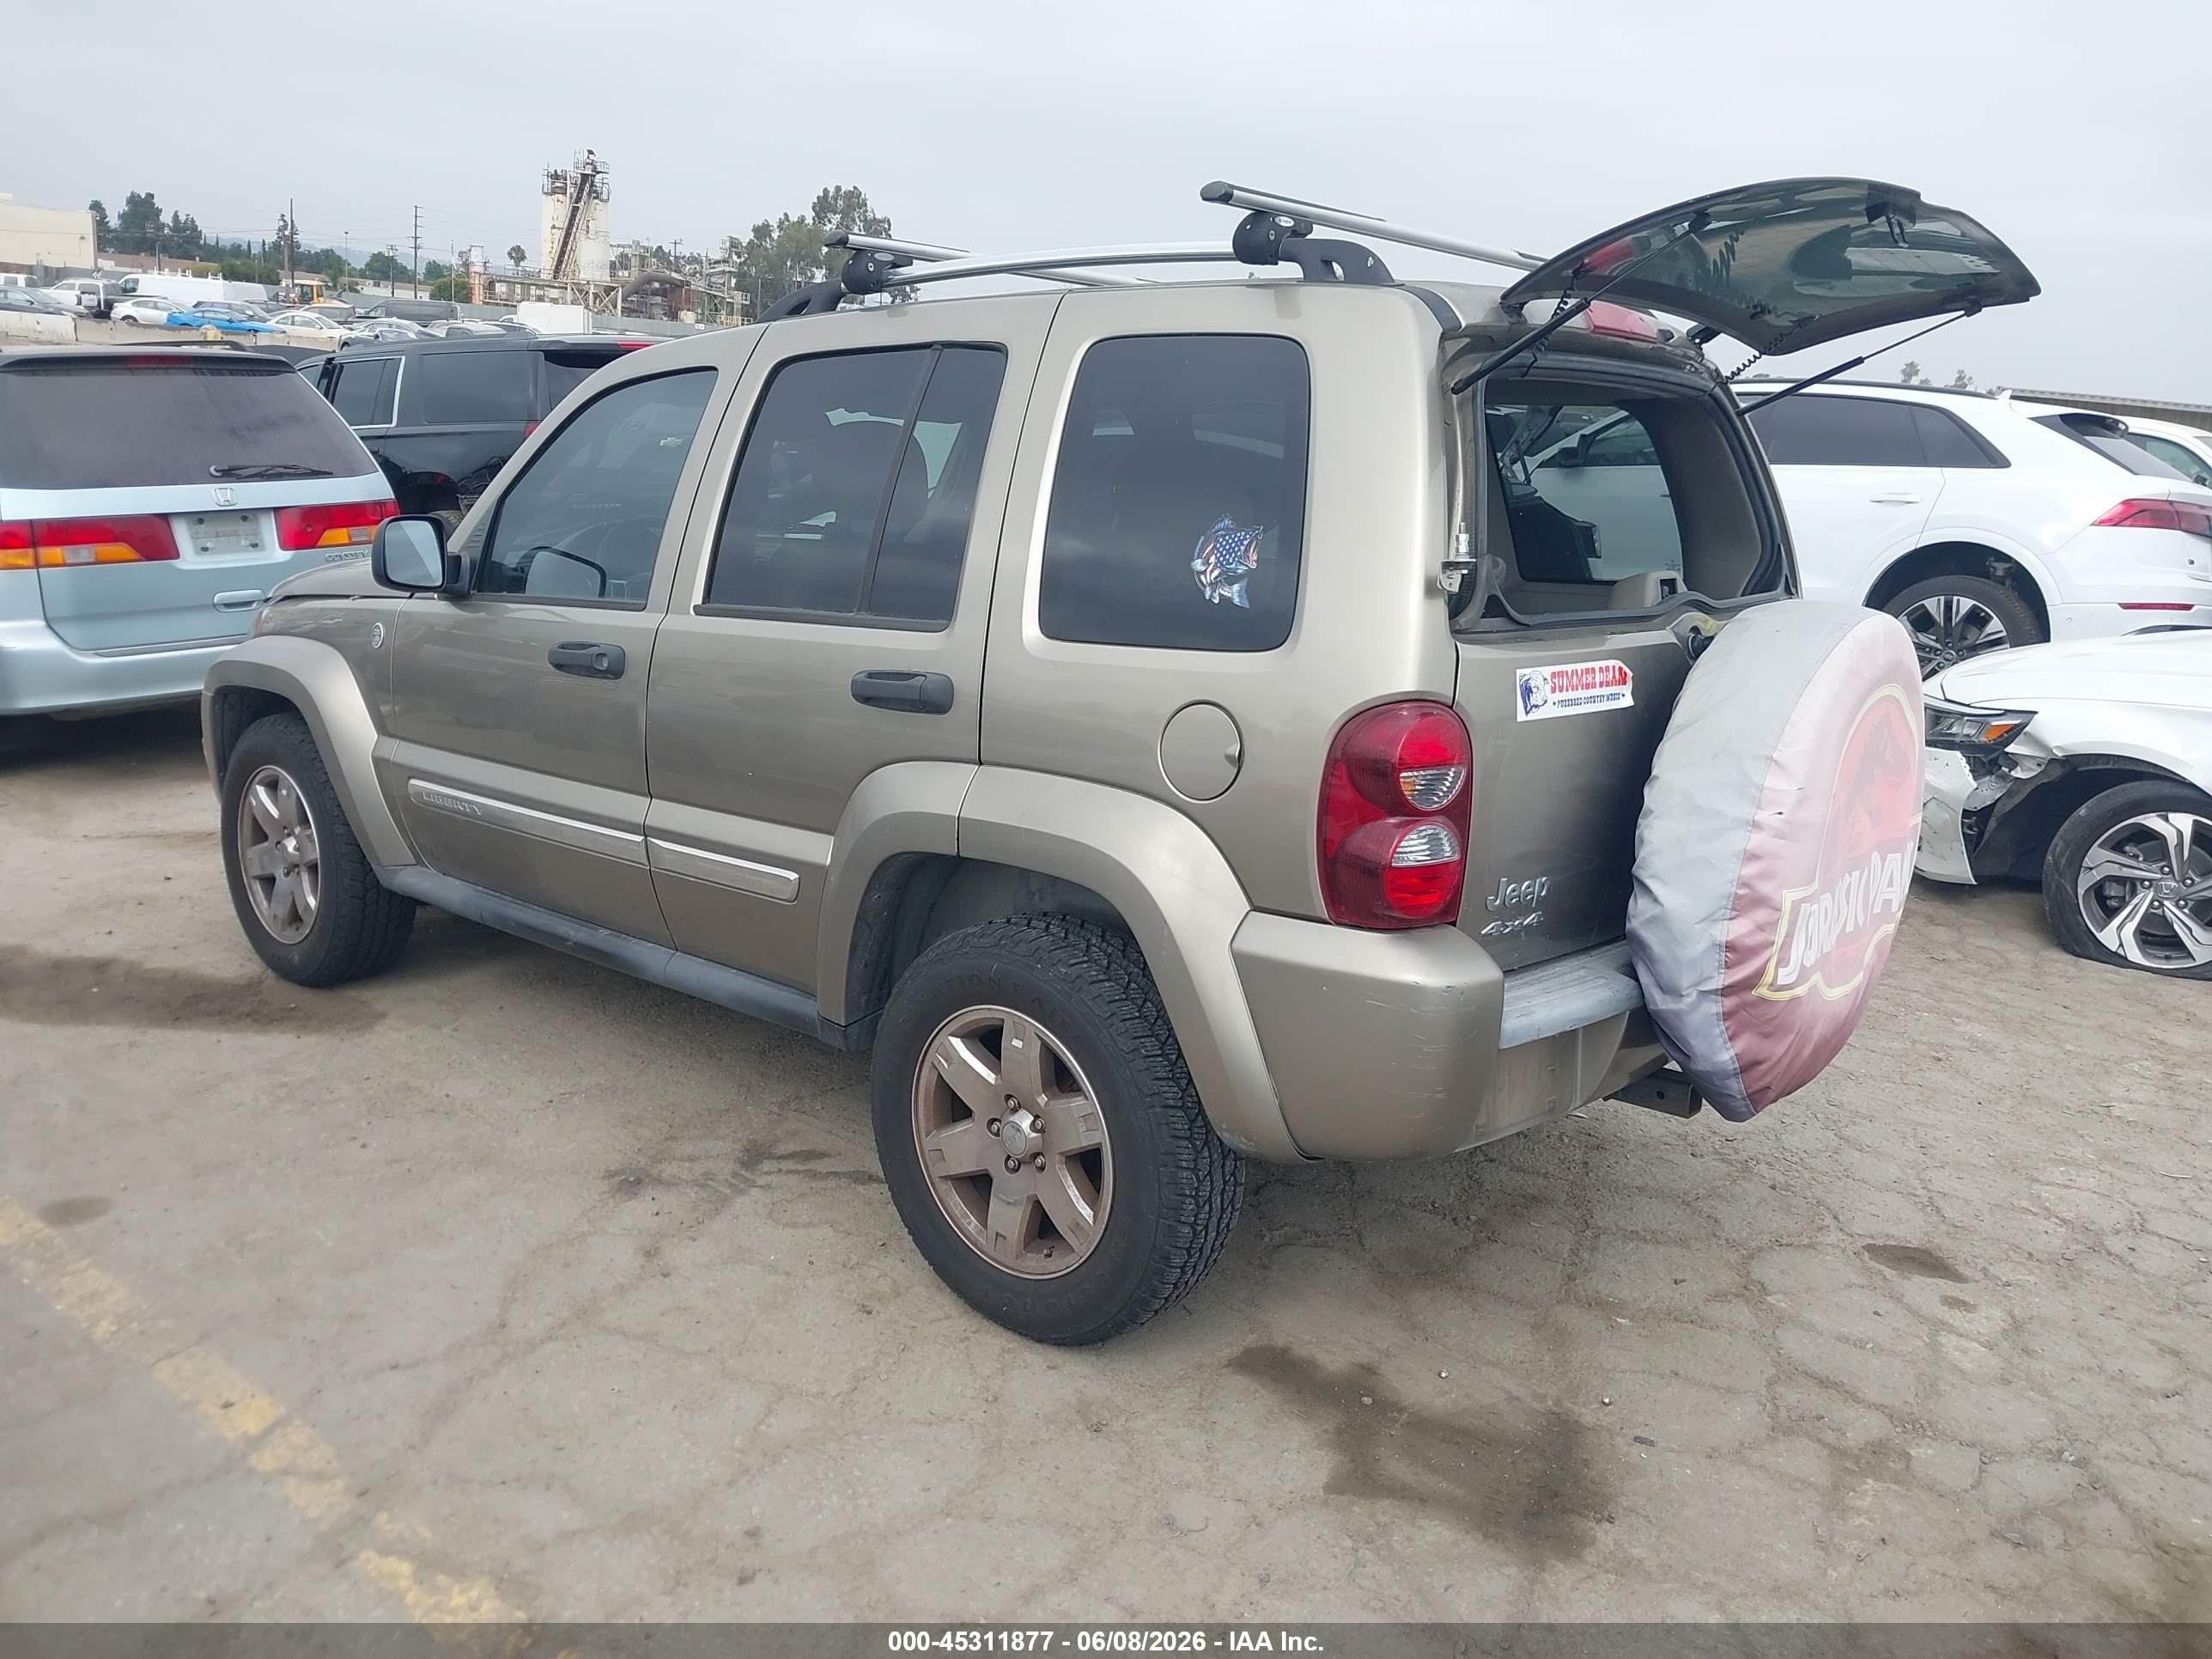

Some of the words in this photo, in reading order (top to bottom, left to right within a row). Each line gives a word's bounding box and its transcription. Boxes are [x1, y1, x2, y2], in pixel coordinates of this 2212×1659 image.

[1550, 666, 1597, 694] SUMMER
[1583, 694, 1606, 705] COUNTRY
[1606, 691, 1621, 702] MUSIC
[1486, 877, 1549, 912] Jeep
